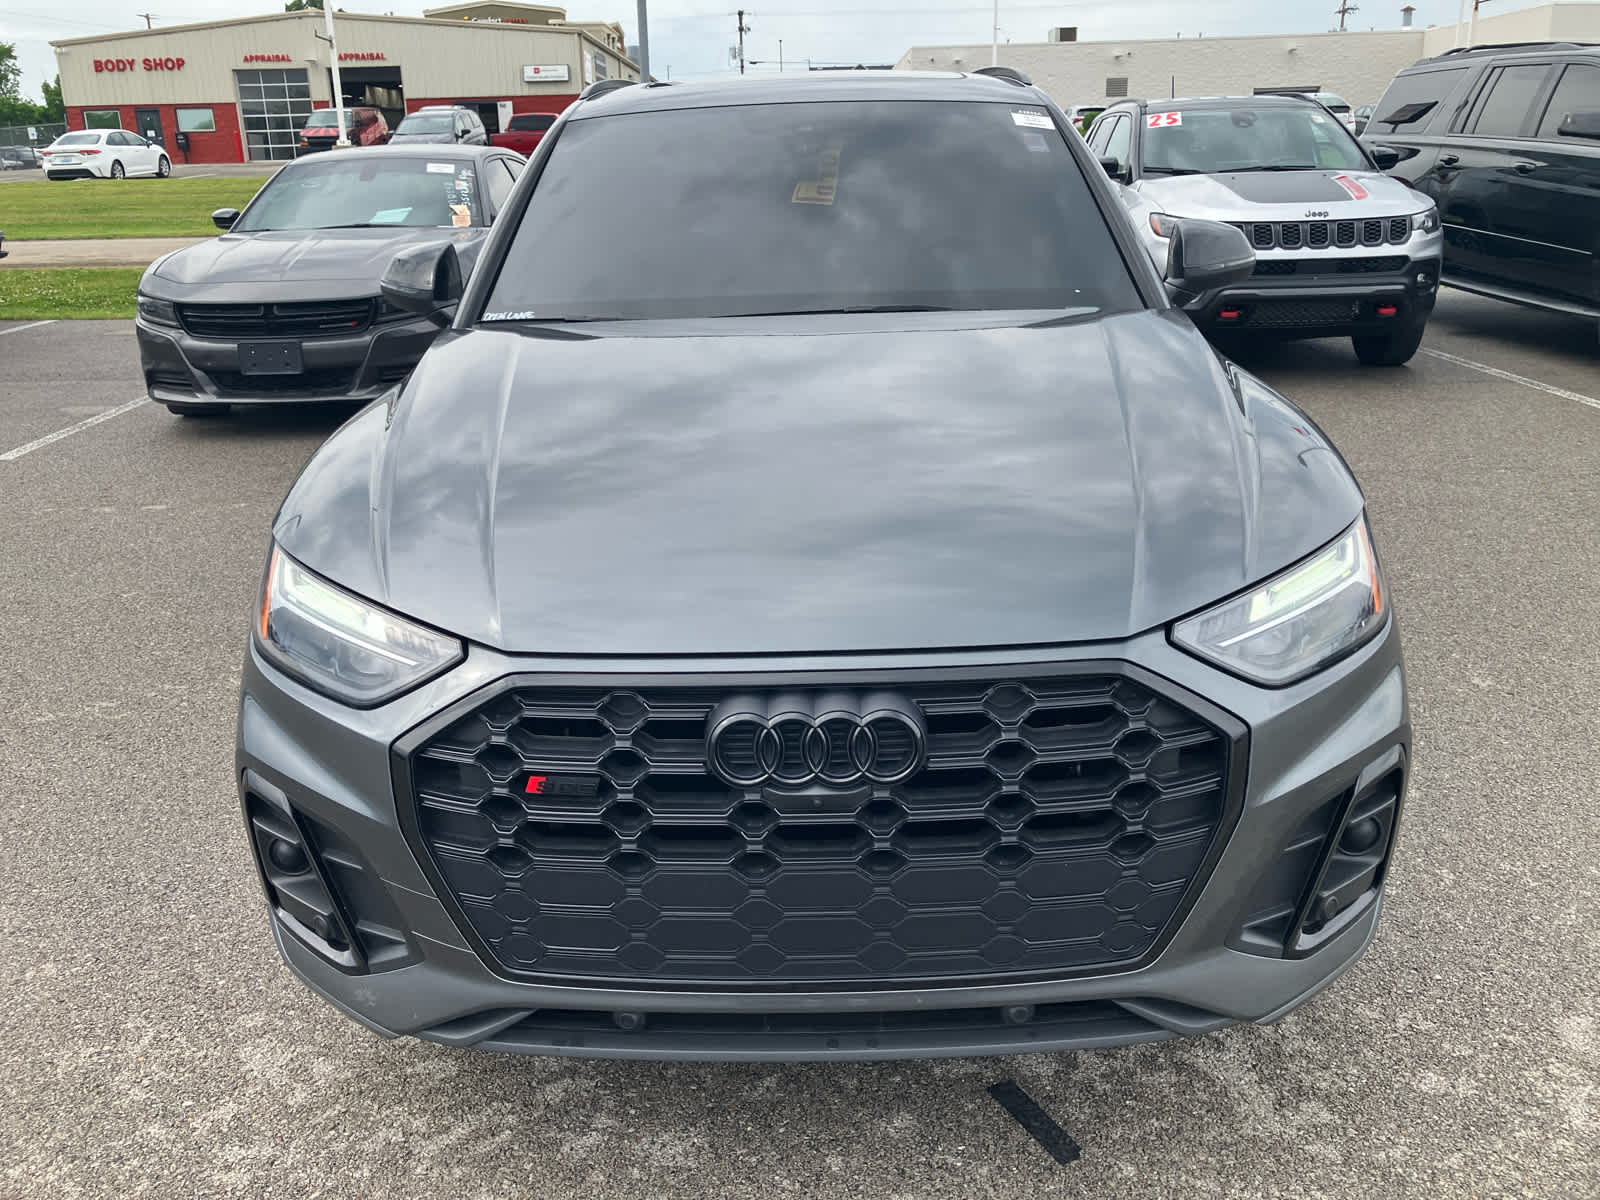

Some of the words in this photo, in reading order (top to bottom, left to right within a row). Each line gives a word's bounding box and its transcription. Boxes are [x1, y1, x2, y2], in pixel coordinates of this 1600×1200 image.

[243, 53, 292, 63] APPRAISAL
[337, 52, 387, 61] APPRAISAL
[93, 59, 135, 72] BODY
[142, 57, 185, 71] SHOP
[1149, 112, 1179, 127] 25
[1304, 210, 1329, 218] Jeep
